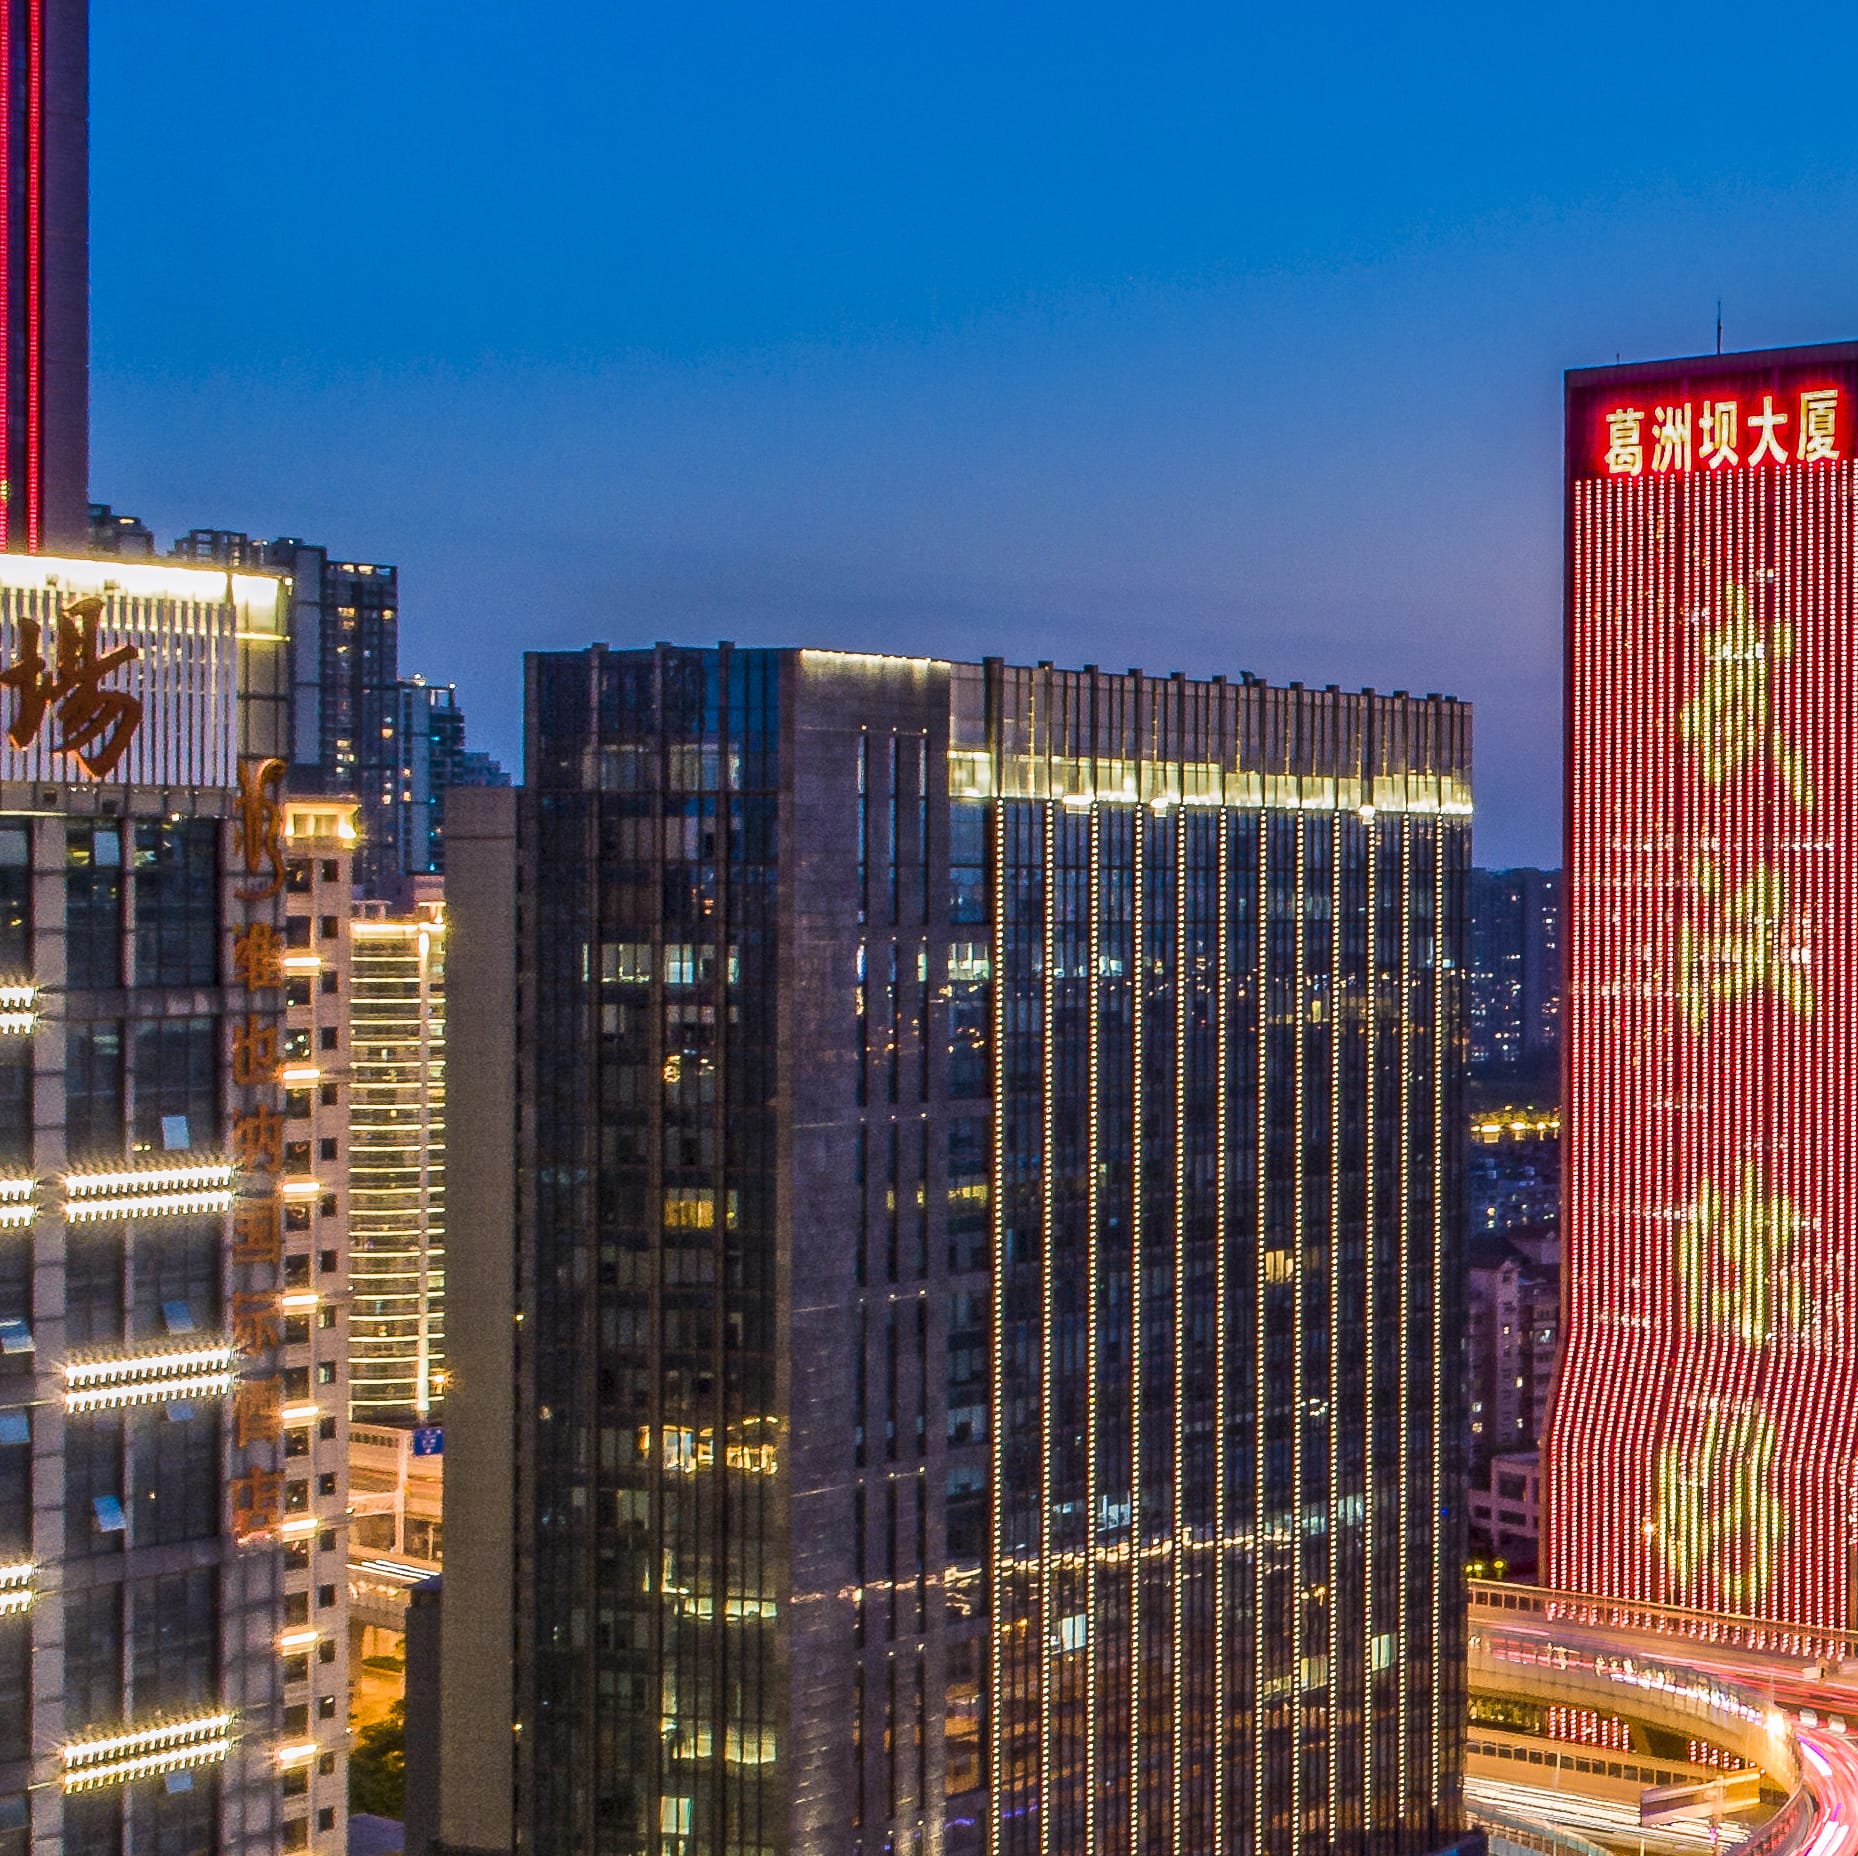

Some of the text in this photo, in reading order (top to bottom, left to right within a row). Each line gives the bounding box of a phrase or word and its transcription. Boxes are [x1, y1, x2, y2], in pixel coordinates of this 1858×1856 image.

[1605, 389, 1840, 476] 葛洲坝大厦
[231, 922, 285, 1541] 维也纳国际酒店
